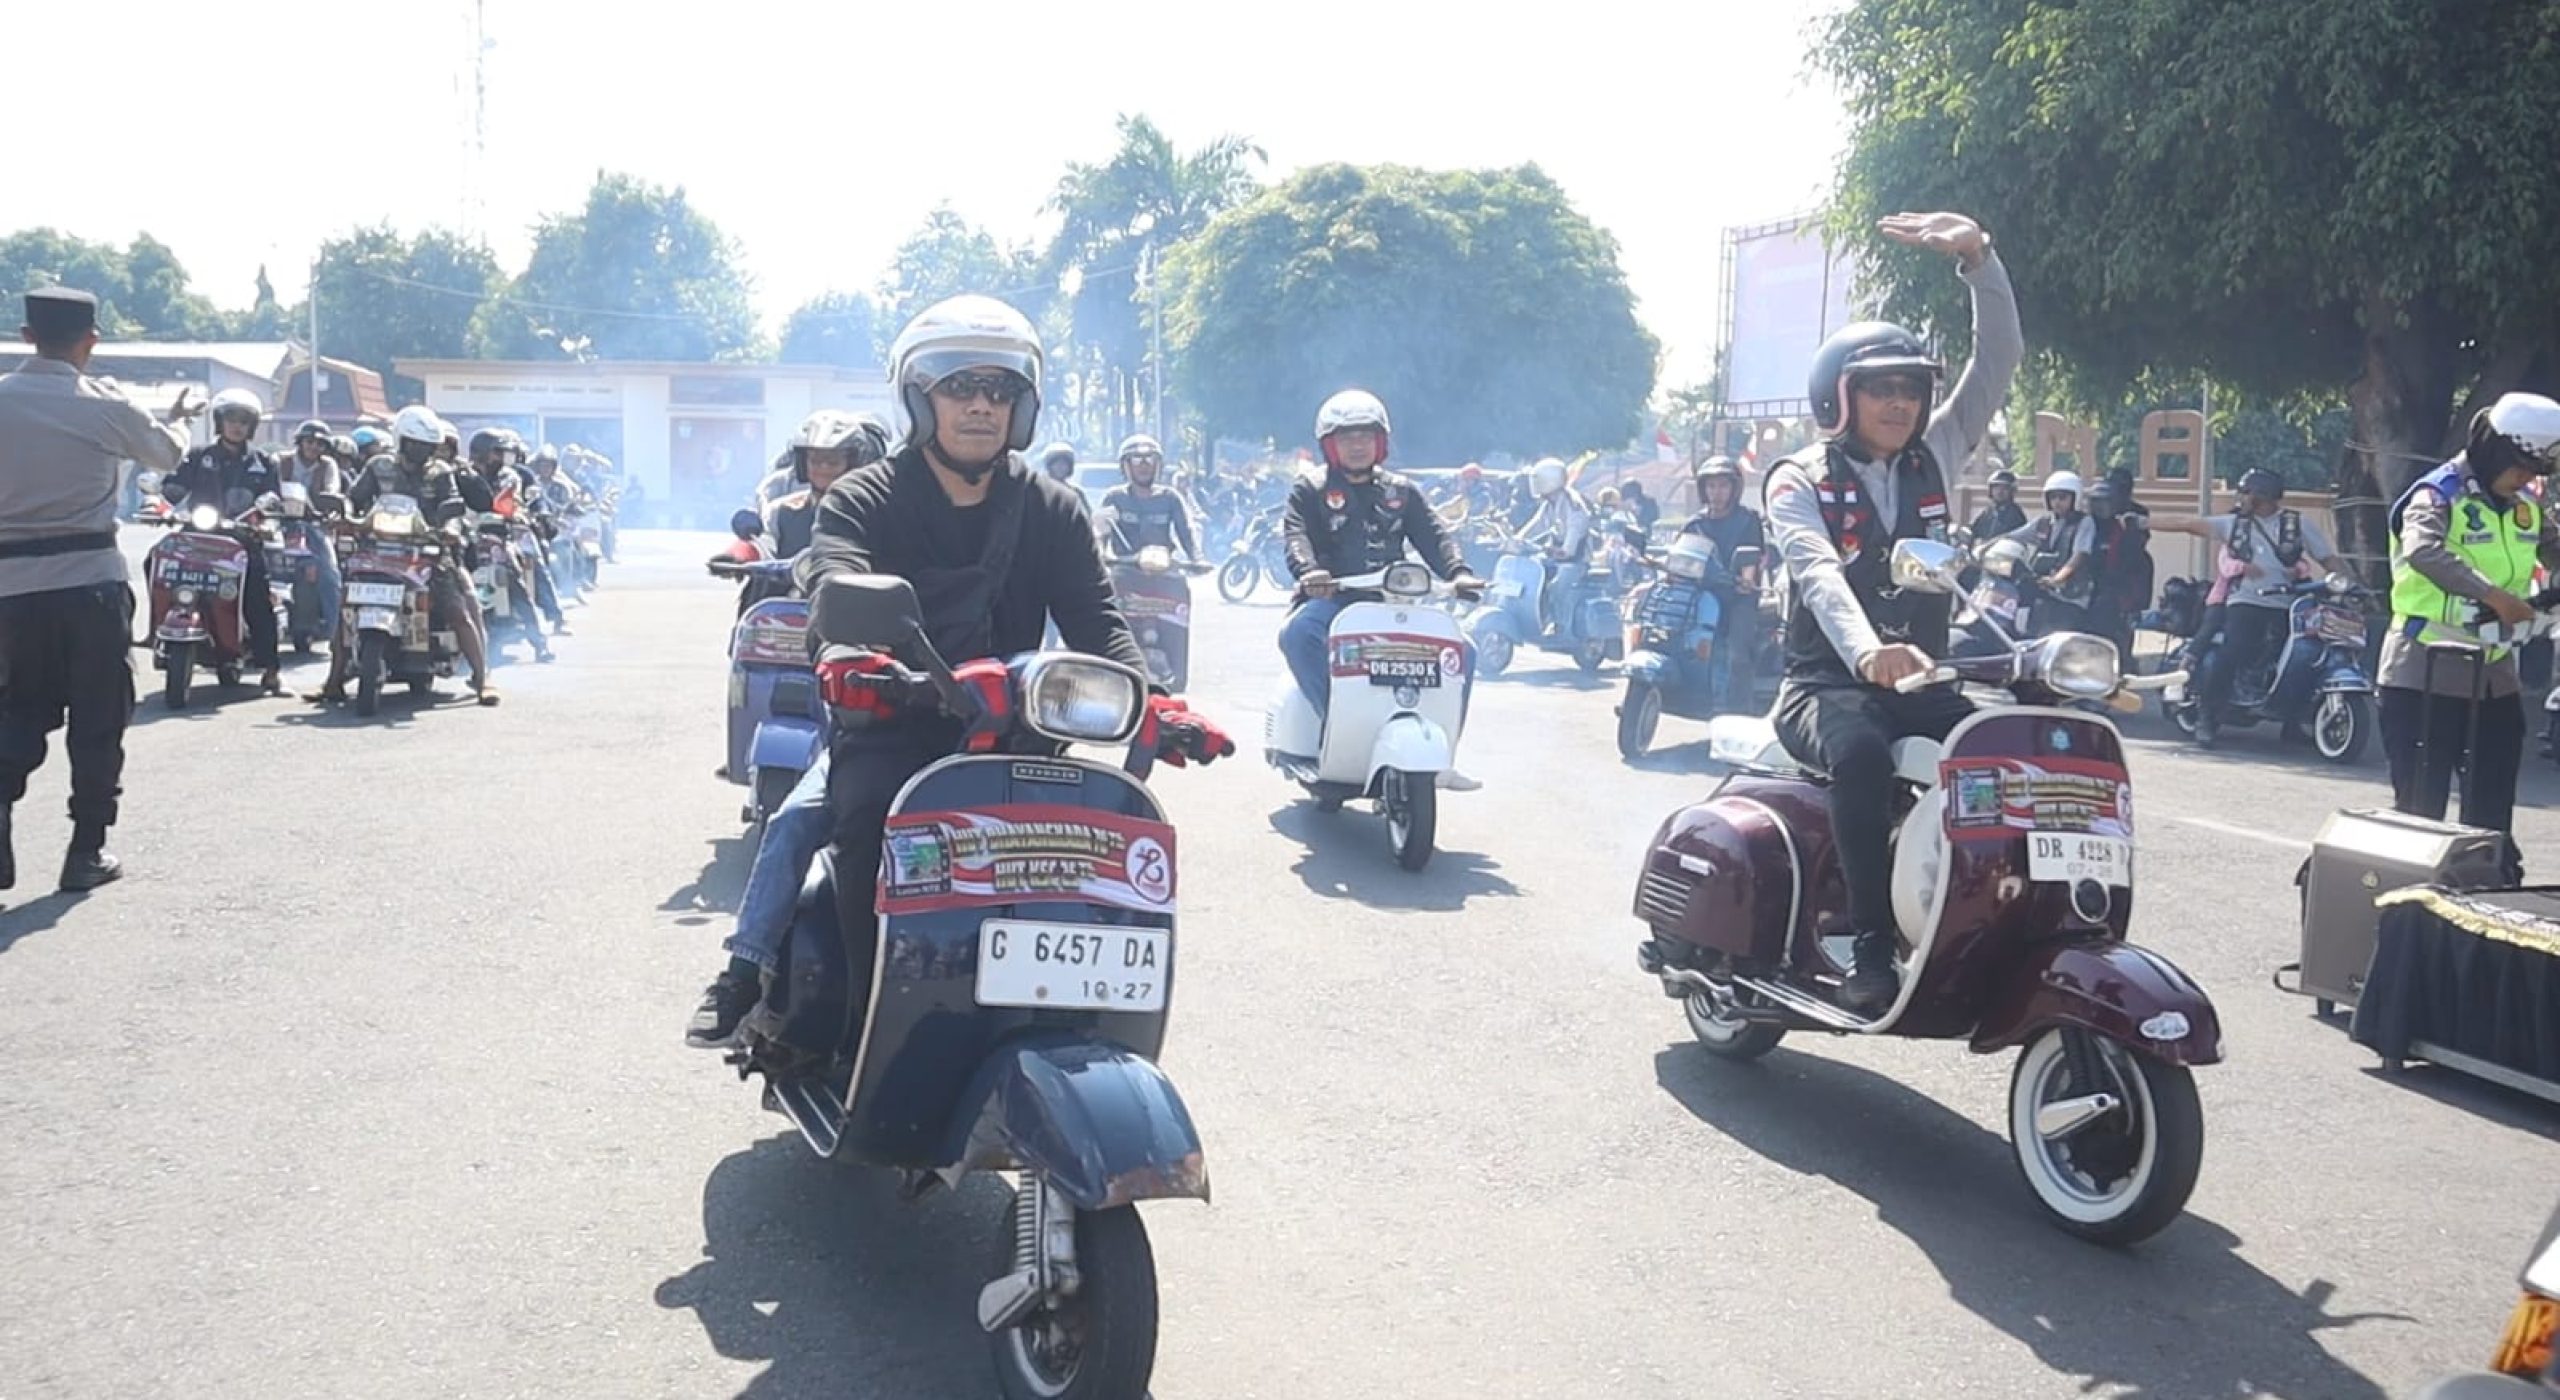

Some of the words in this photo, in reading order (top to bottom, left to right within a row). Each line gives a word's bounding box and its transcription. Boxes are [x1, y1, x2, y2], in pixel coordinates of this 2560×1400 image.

[1391, 662, 1425, 677] 2530
[2035, 836, 2064, 858] DR
[990, 928, 1008, 960] G
[1034, 931, 1104, 966] 6457
[1123, 937, 1156, 969] DA
